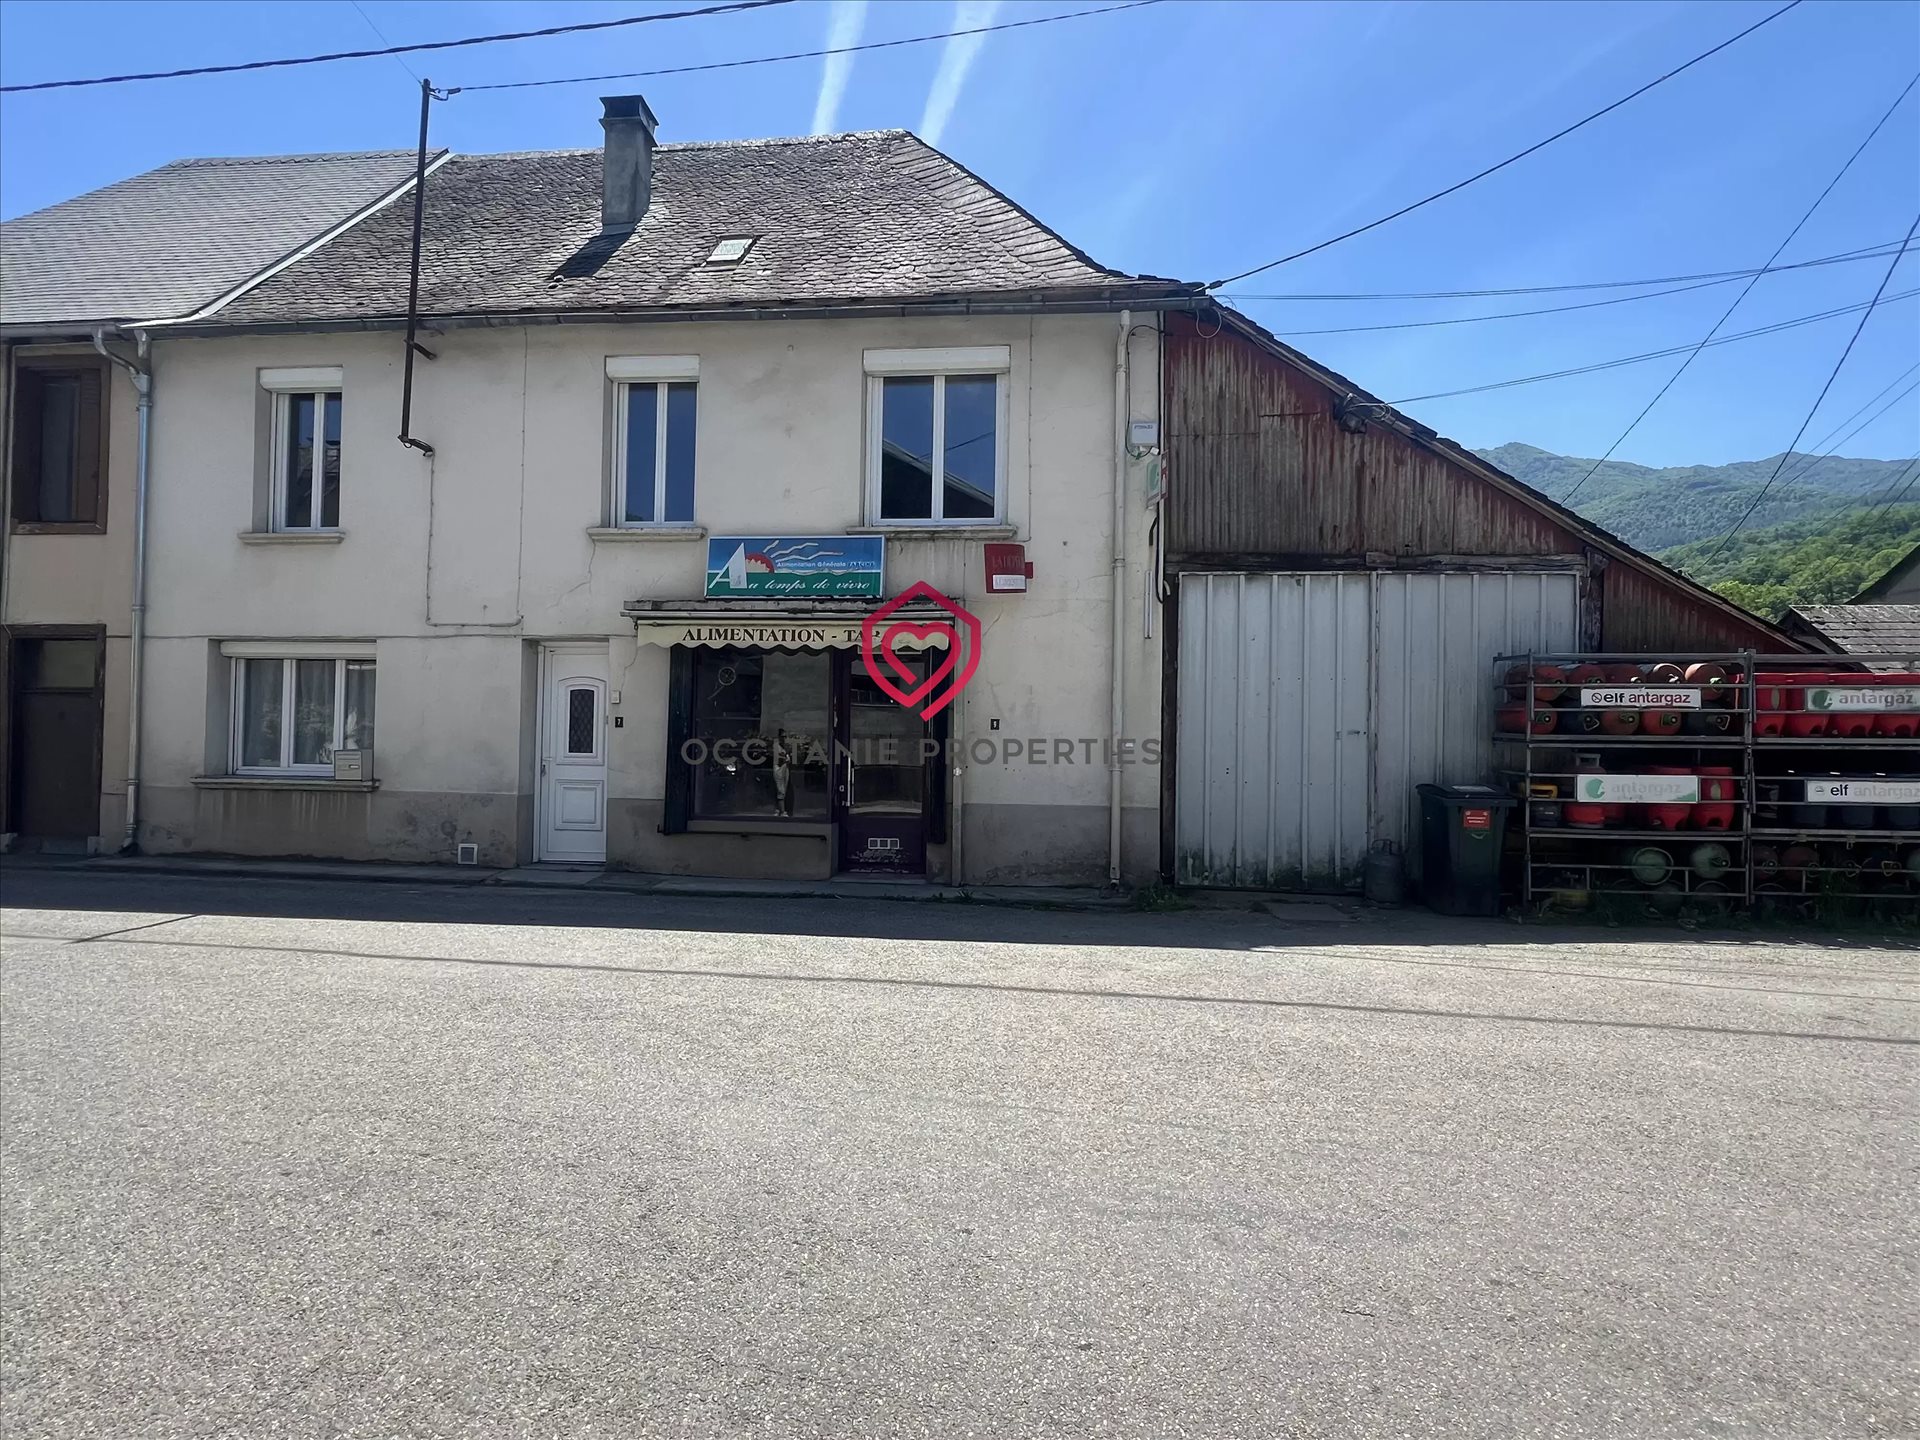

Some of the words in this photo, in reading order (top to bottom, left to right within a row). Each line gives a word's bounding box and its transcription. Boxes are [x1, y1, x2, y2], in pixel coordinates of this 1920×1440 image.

[682, 628, 825, 642] ALIMENTATION
[1603, 692, 1625, 703] elf
[1628, 691, 1691, 706] antargaz
[1839, 692, 1914, 707] antargaz
[1830, 784, 1849, 796] elf
